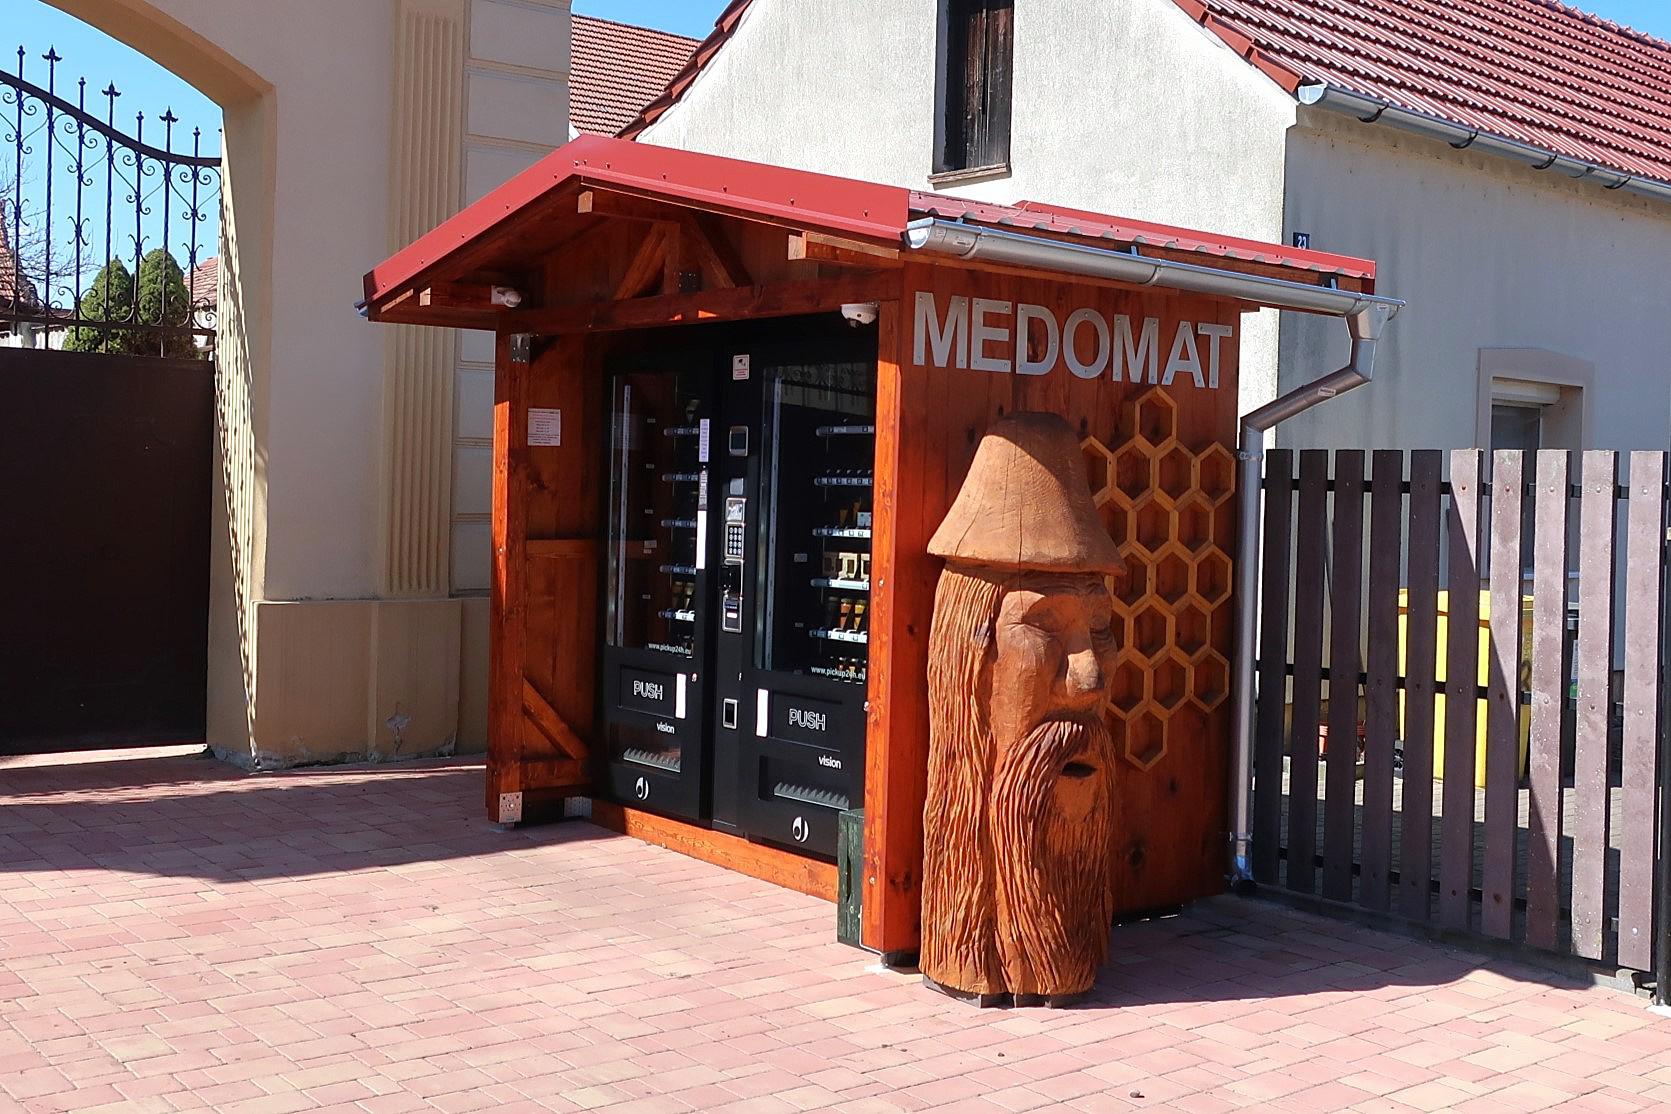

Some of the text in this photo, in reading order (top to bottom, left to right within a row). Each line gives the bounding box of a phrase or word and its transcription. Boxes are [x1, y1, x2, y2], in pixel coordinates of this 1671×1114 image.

[913, 291, 1233, 389] MEDOMAT
[648, 643, 692, 655] www.pickup24h.eu
[811, 666, 866, 680] www.pickup24h.eu
[633, 680, 663, 700] PUSH
[788, 708, 826, 731] PUSH
[656, 722, 675, 734] vision
[818, 755, 842, 769] vision
